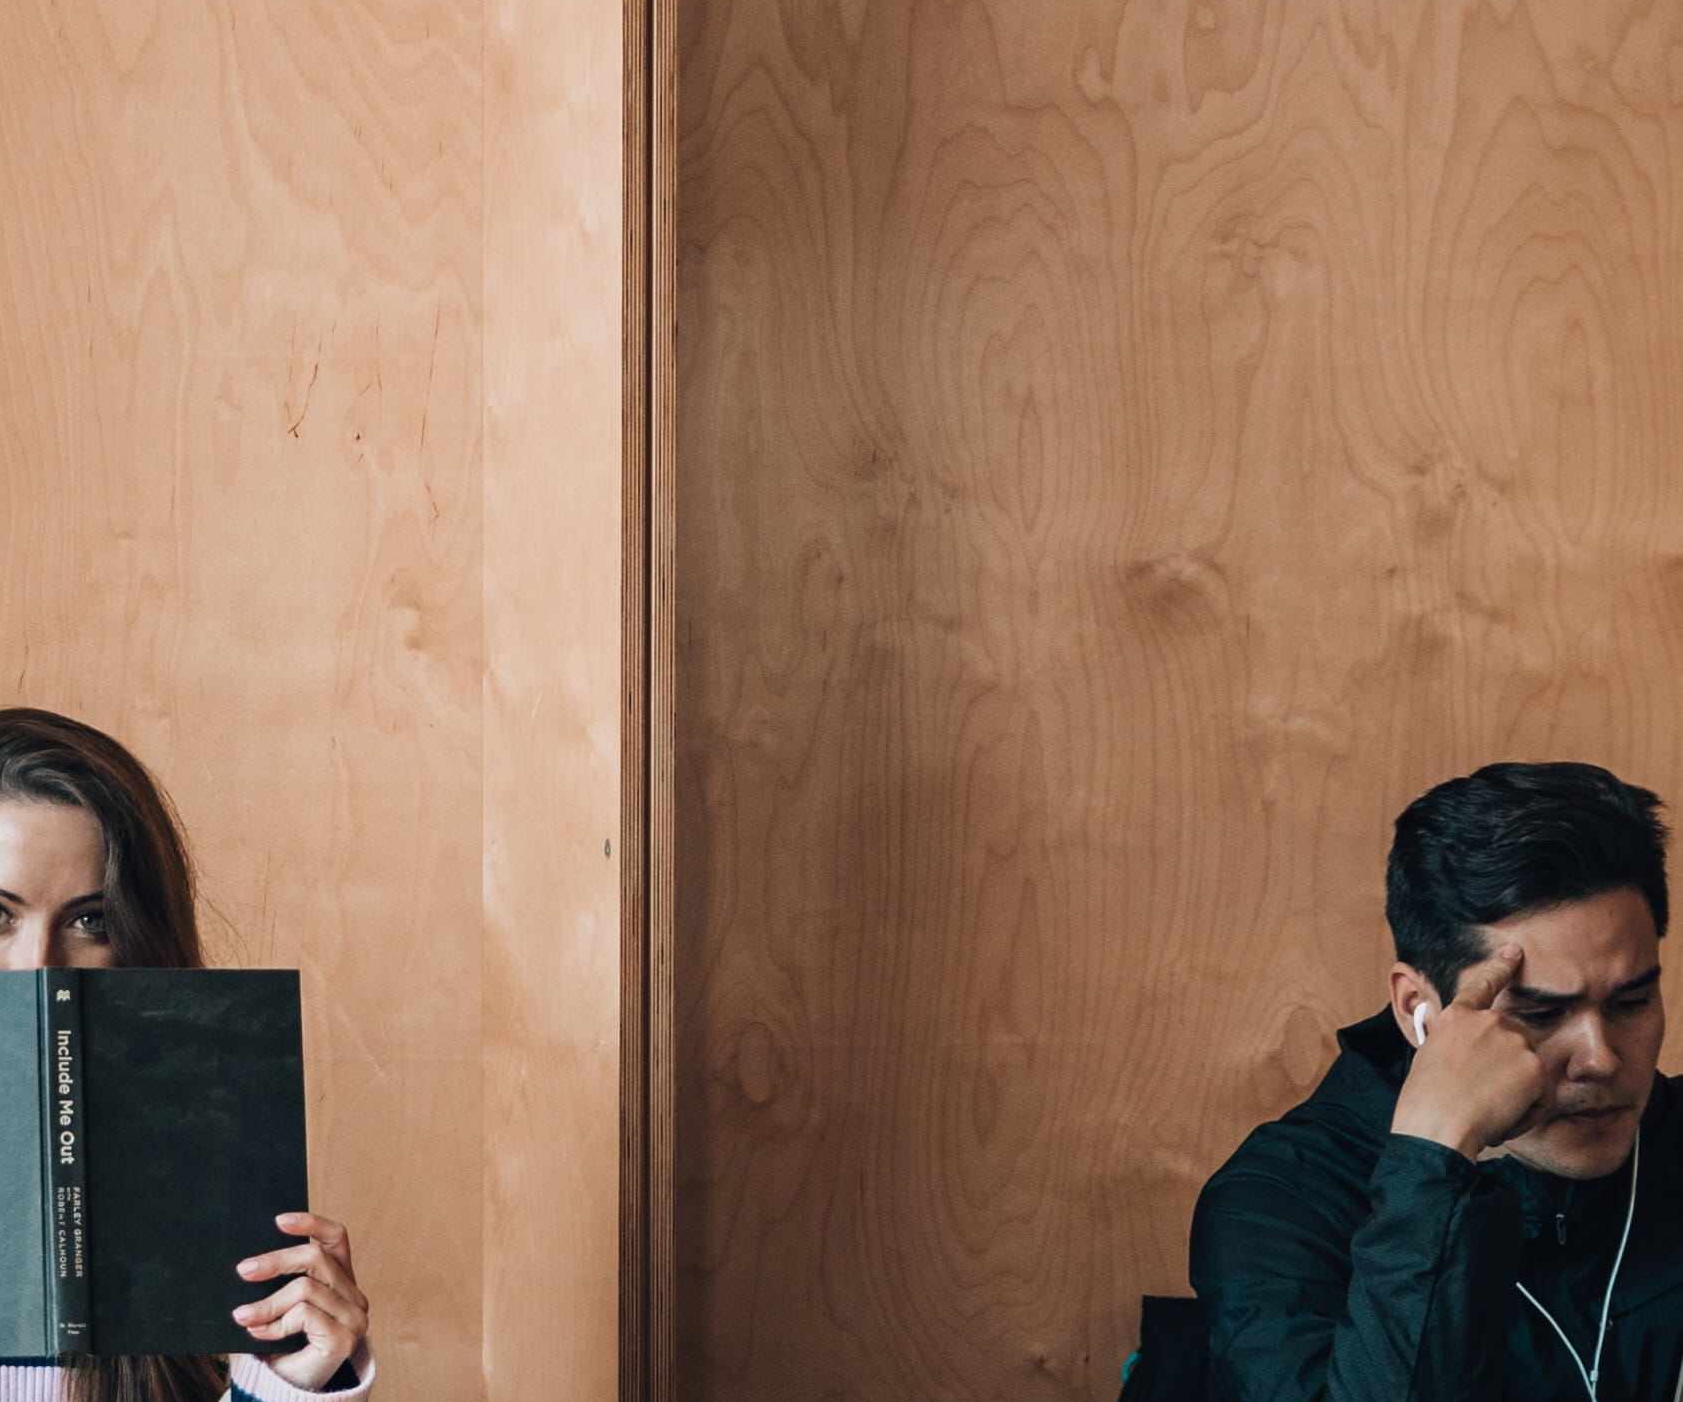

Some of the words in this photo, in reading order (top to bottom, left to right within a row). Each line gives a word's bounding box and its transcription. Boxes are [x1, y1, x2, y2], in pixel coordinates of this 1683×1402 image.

[57, 1030, 74, 1094] Include
[59, 1100, 74, 1126] Me
[60, 1131, 75, 1165] Out
[73, 1186, 82, 1226] FARLEY
[58, 1229, 67, 1278] CALHOUN
[74, 1228, 83, 1278] GRANGER
